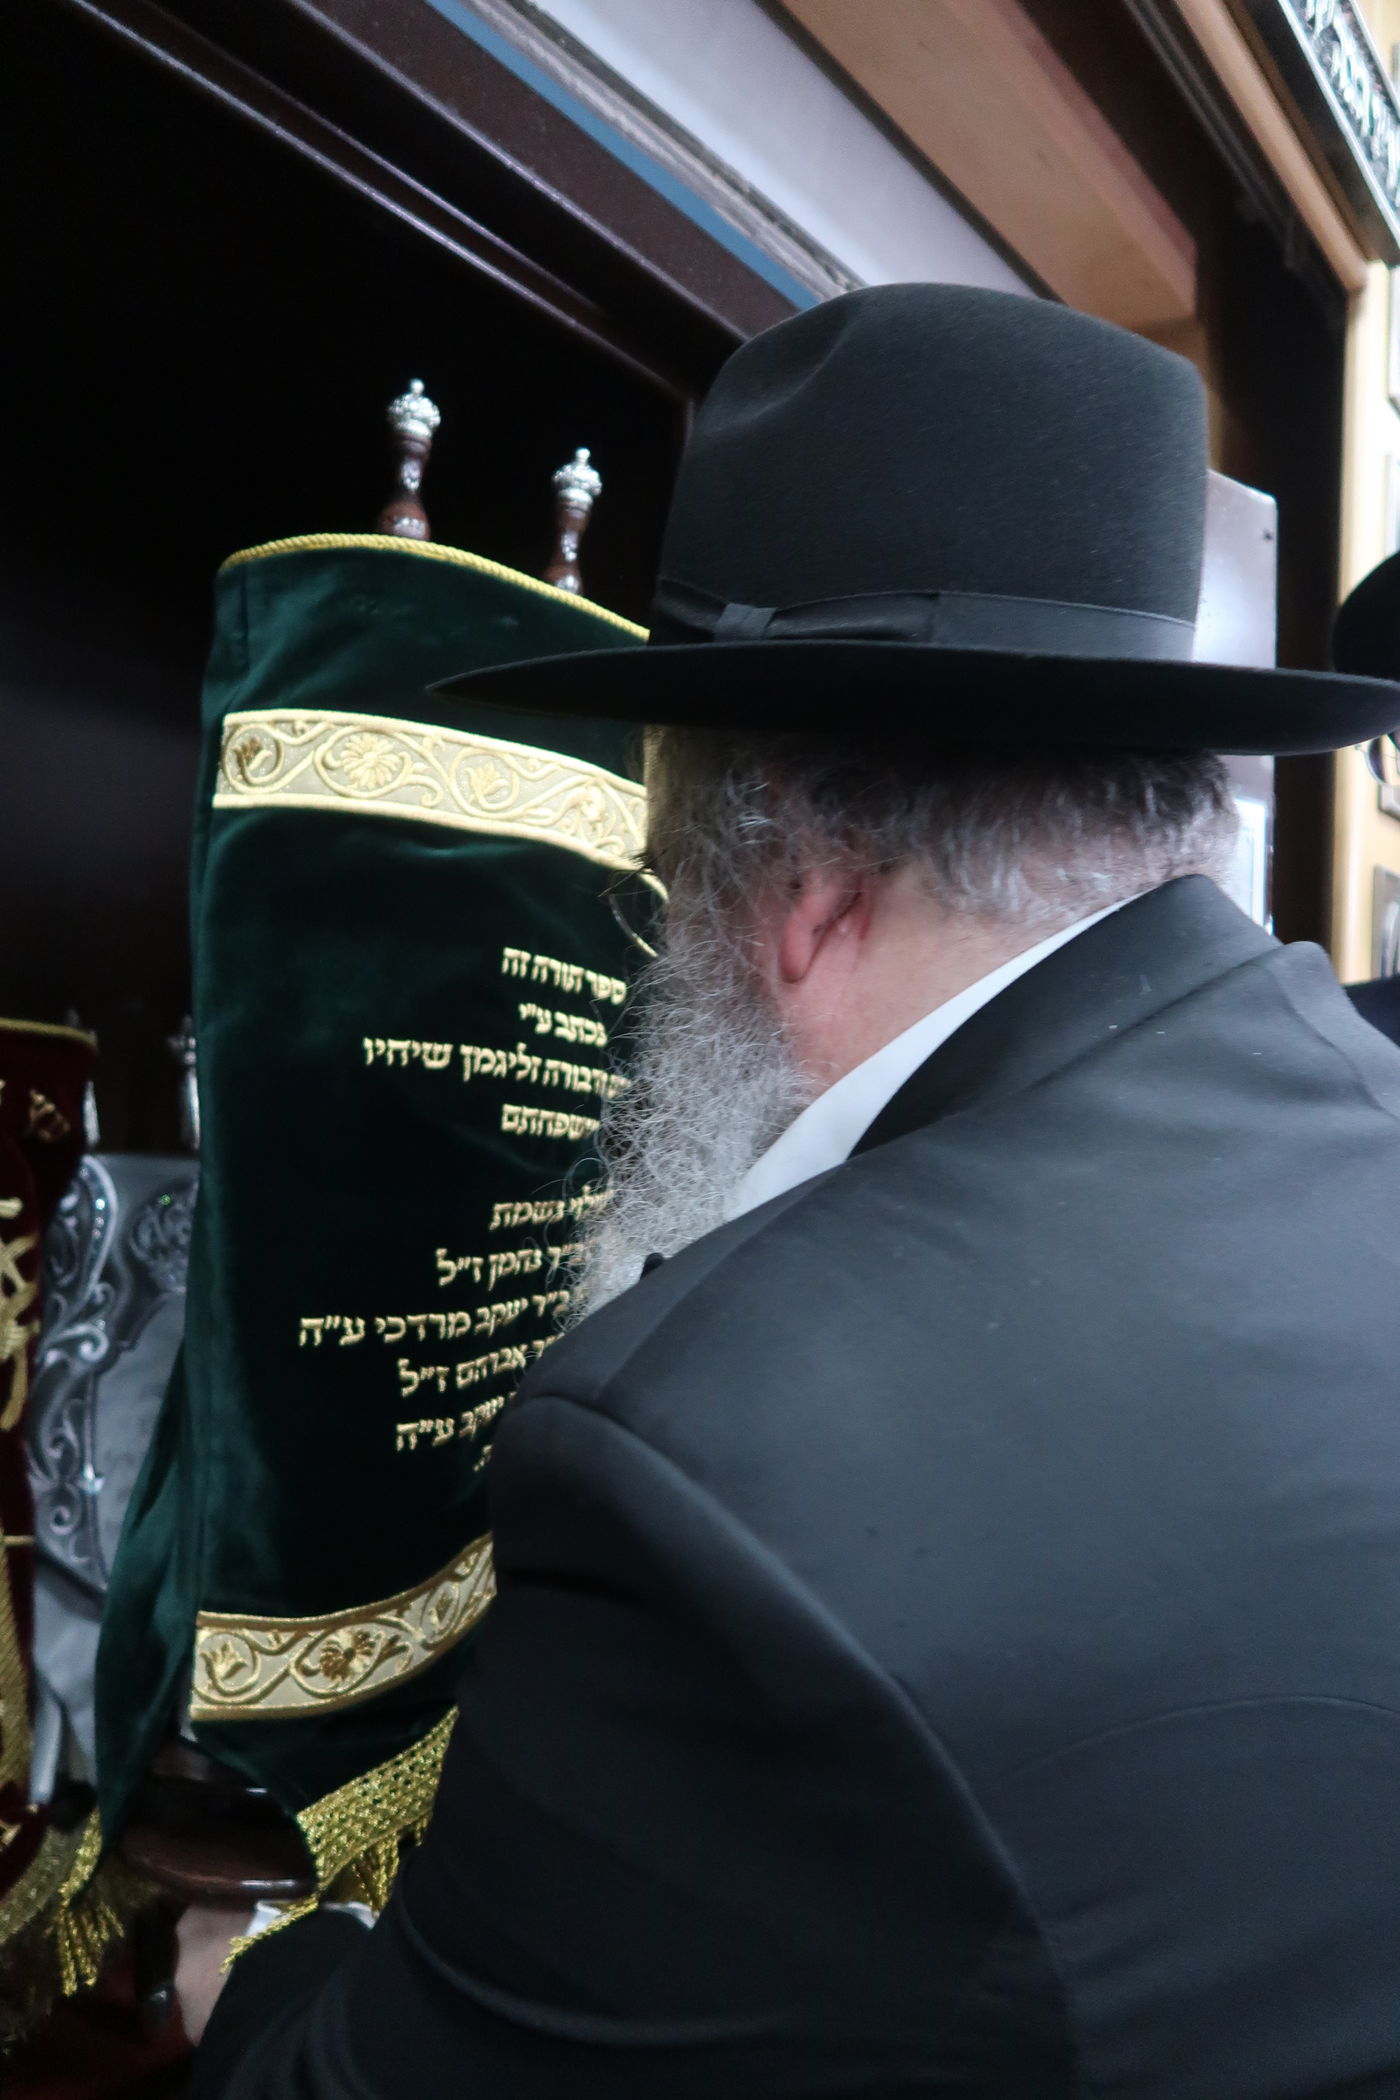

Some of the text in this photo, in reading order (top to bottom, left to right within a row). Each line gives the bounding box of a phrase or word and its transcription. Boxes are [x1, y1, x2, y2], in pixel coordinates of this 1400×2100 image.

[501, 947, 627, 1005] ספר תורה זה
[554, 1011, 608, 1047] נכתב
[363, 1037, 453, 1069] שיחיו
[489, 1200, 565, 1230] נשמת
[374, 1312, 471, 1343] מרדכי
[474, 1297, 529, 1338] יעקב
[456, 1343, 528, 1389] אברהם
